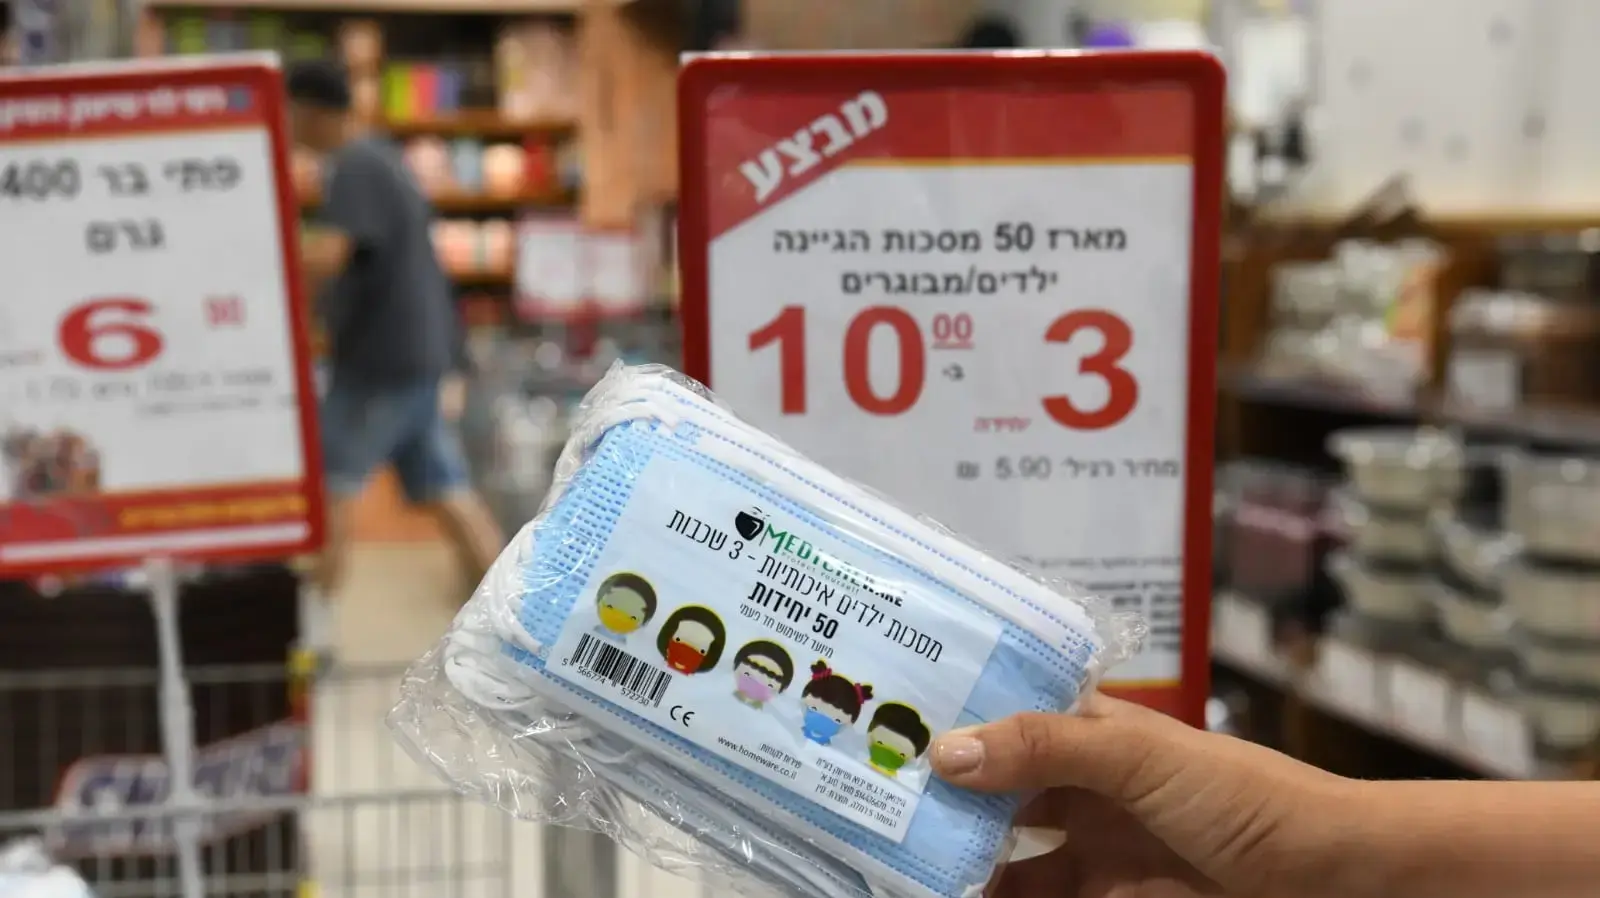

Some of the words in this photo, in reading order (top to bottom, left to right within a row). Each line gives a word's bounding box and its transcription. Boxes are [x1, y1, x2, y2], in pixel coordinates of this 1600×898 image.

[738, 90, 889, 203] מבצע
[773, 229, 871, 252] הגיינה
[882, 229, 982, 252] מסכות
[993, 222, 1034, 252] 50
[1045, 227, 1128, 250] מארז
[841, 265, 1058, 295] ילדים/מבוגרים
[57, 296, 165, 372] 6
[746, 305, 926, 417] 10
[932, 312, 974, 342] 00
[1040, 308, 1140, 432] 3
[995, 455, 1052, 480] 5.90
[1120, 457, 1181, 479] מחיר
[666, 510, 728, 551] שכבות
[728, 541, 744, 560] 3
[757, 555, 835, 606] איכותיות
[748, 582, 811, 623] יחידות
[836, 597, 886, 629] ילדים
[812, 613, 839, 639] 50
[884, 619, 943, 662] מסכות
[577, 666, 605, 684] 566774
[621, 687, 650, 706] 572730
[718, 736, 798, 780] www.homeware.co.il
